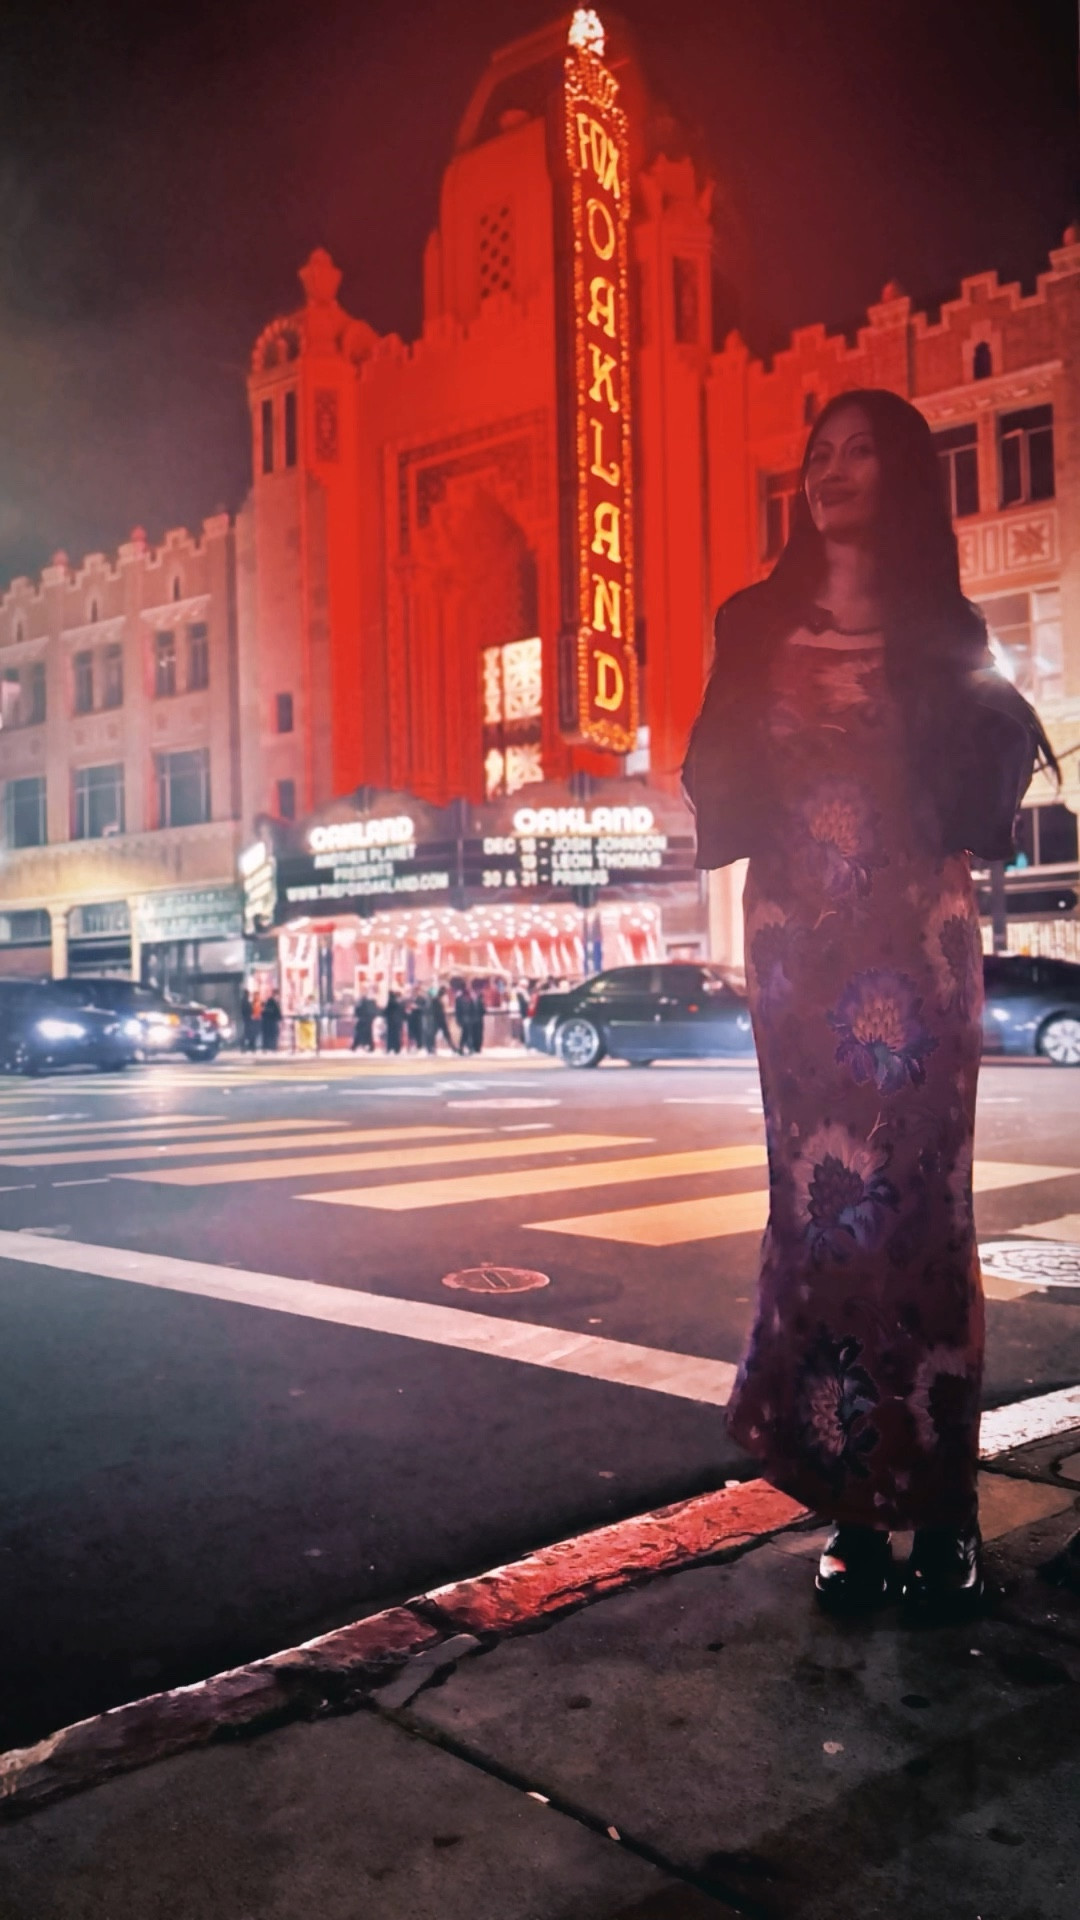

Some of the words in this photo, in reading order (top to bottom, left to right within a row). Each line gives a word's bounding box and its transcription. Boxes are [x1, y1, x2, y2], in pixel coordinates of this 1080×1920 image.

[576, 113, 620, 199] FOX
[587, 198, 624, 711] OAKLAND
[513, 807, 654, 834] OAKLAND
[310, 816, 414, 850] OAKLAND
[370, 843, 416, 862] PLANET
[483, 837, 516, 855] DEC
[551, 836, 593, 852] JOSH
[595, 835, 667, 851] JOHNSON
[552, 853, 593, 870] LEON
[596, 851, 661, 868] THOMAS
[505, 870, 517, 887] &
